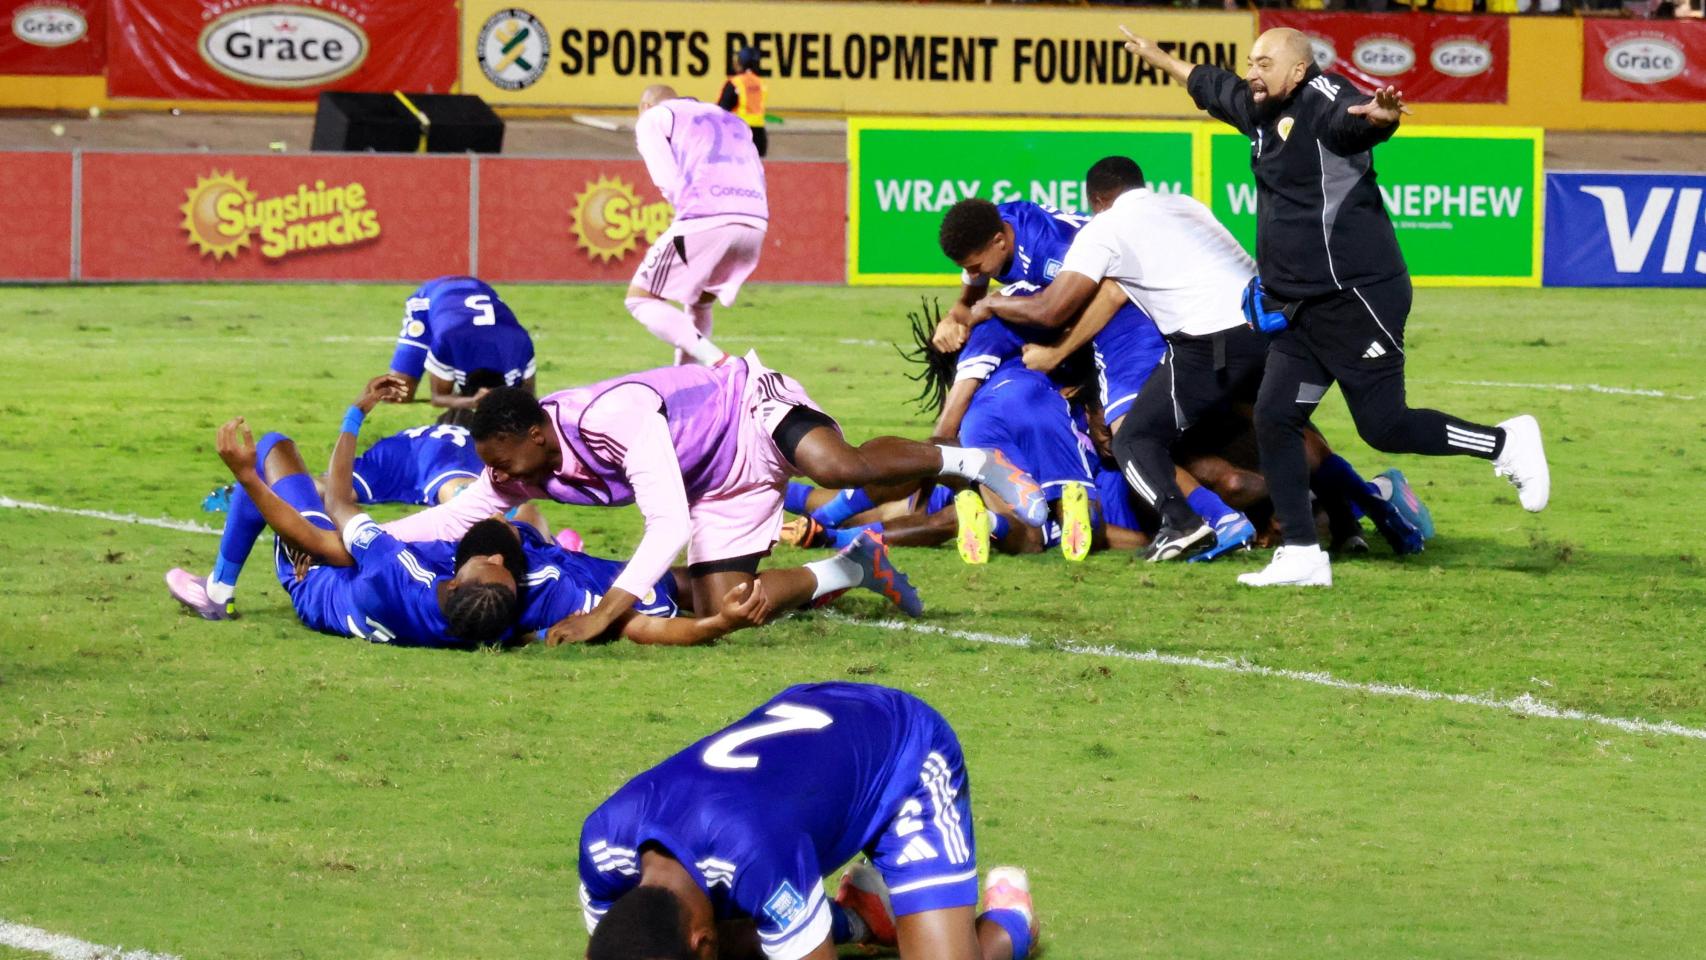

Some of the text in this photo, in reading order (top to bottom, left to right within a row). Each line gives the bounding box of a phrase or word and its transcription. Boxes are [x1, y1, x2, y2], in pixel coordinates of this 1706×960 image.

[225, 31, 343, 61] Grace
[560, 28, 710, 77] SPORTS
[725, 31, 998, 83] DEVELOPMENT
[1361, 50, 1406, 65] Grace
[1439, 51, 1483, 66] Grace
[1616, 50, 1674, 70] Grace
[216, 179, 368, 236] Sunshine
[874, 179, 981, 212] WRAY
[1378, 184, 1523, 218] NEPHEW
[260, 208, 381, 258] Snacks
[464, 294, 496, 326] 5
[702, 703, 834, 769] 2
[896, 799, 924, 838] 2
